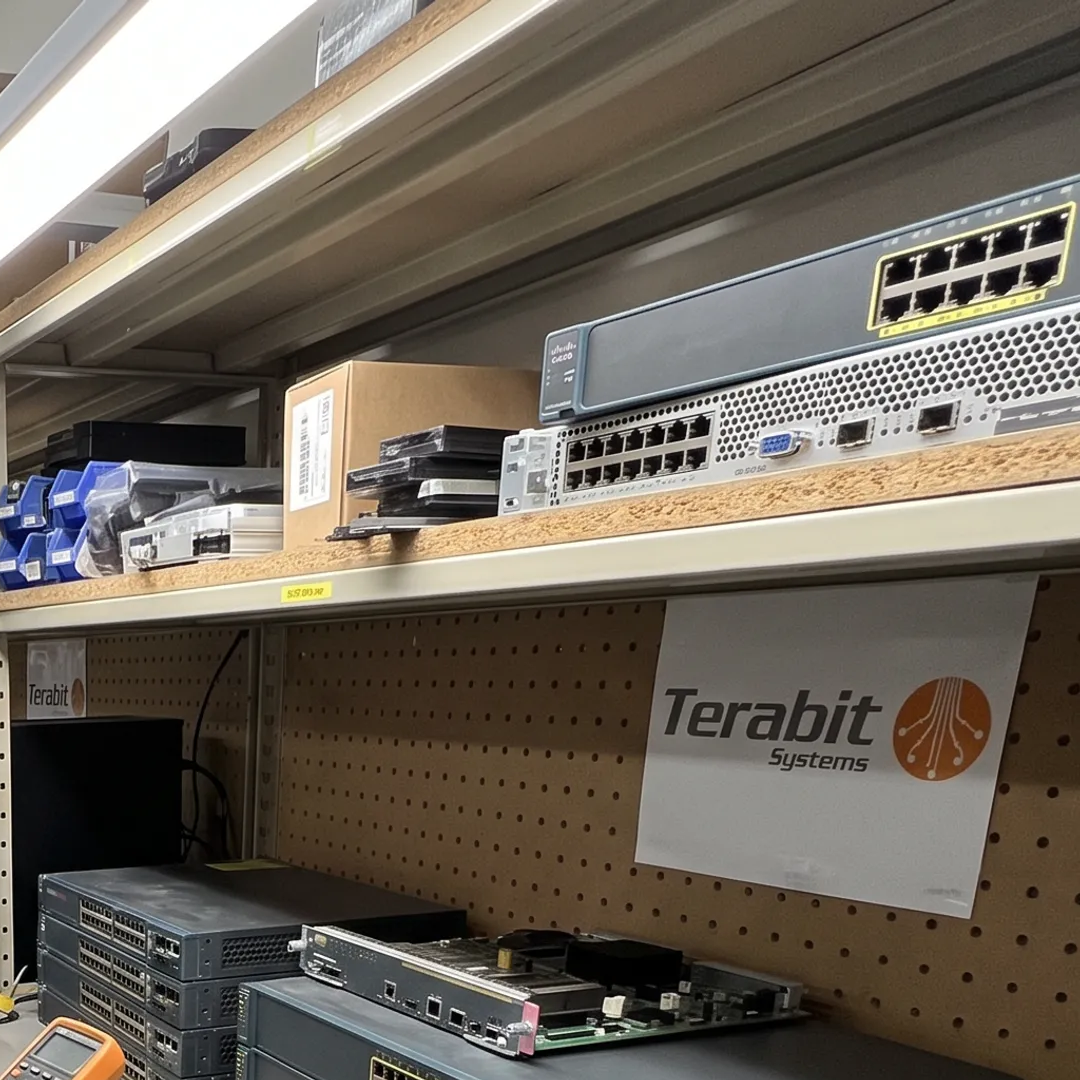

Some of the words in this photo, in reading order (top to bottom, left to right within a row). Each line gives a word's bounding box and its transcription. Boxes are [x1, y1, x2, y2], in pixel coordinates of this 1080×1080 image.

[29, 684, 69, 706] Terabit
[663, 688, 883, 746] Terabit
[768, 748, 870, 773] Systems
